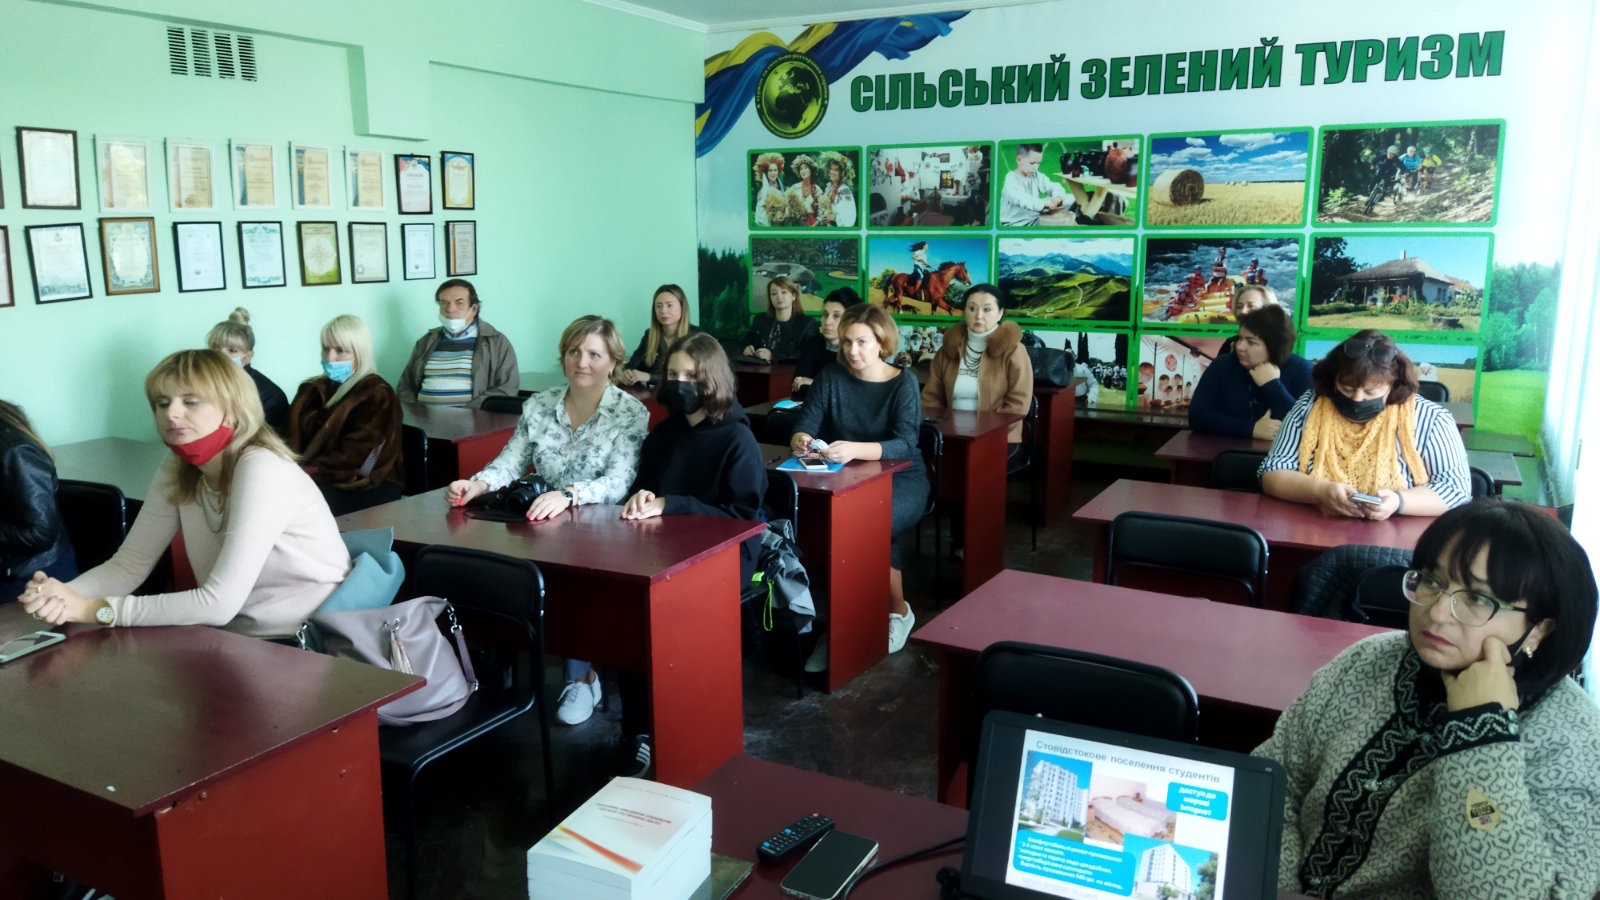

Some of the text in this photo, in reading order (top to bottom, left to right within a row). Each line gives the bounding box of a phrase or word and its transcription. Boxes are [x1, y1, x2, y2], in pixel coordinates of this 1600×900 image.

[850, 30, 1506, 113] СІЛЬСЬКИЙ ЗЕЛЕНИЙ ТУРИЗМ
[1036, 740, 1220, 784] Стовідстокове поселення студентів
